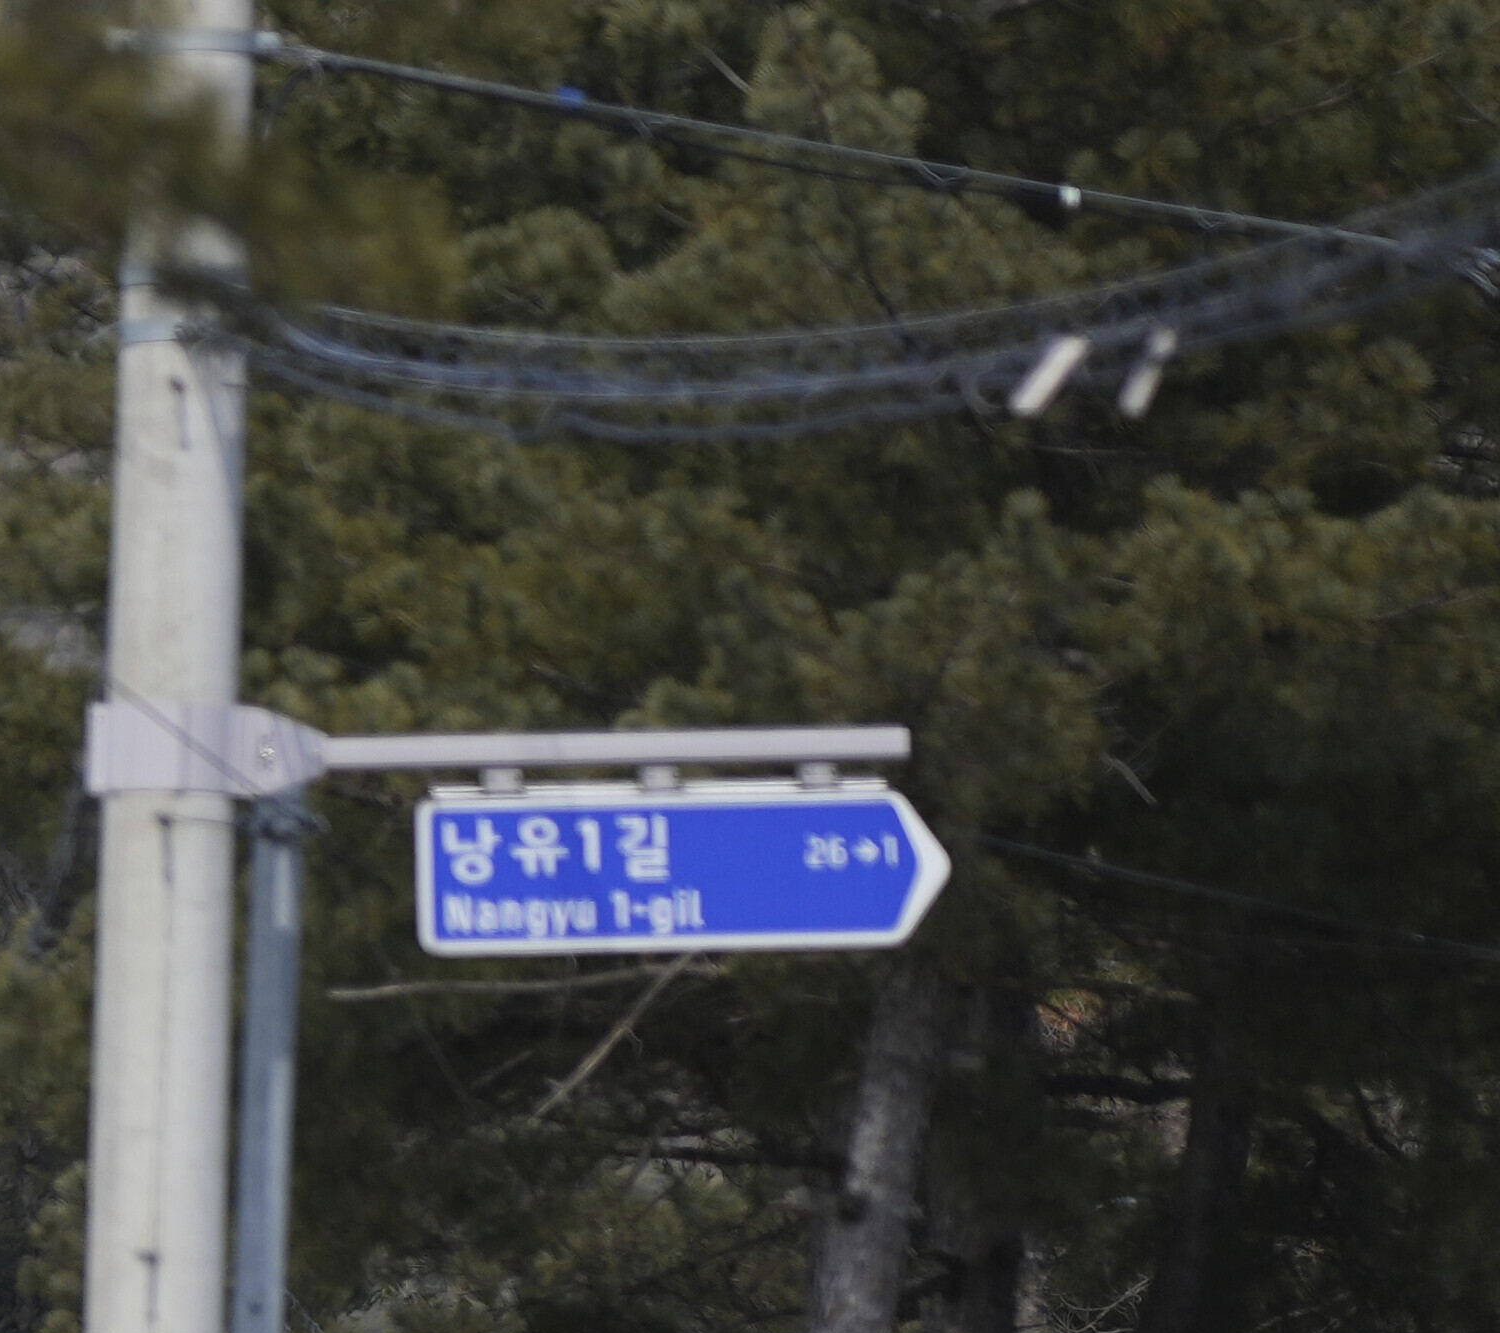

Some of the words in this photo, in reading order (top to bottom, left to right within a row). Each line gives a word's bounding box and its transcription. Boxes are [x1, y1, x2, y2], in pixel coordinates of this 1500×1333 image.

[440, 813, 671, 886] 낭유1길
[443, 892, 597, 938] Nangyu
[608, 886, 705, 936] 1-gil
